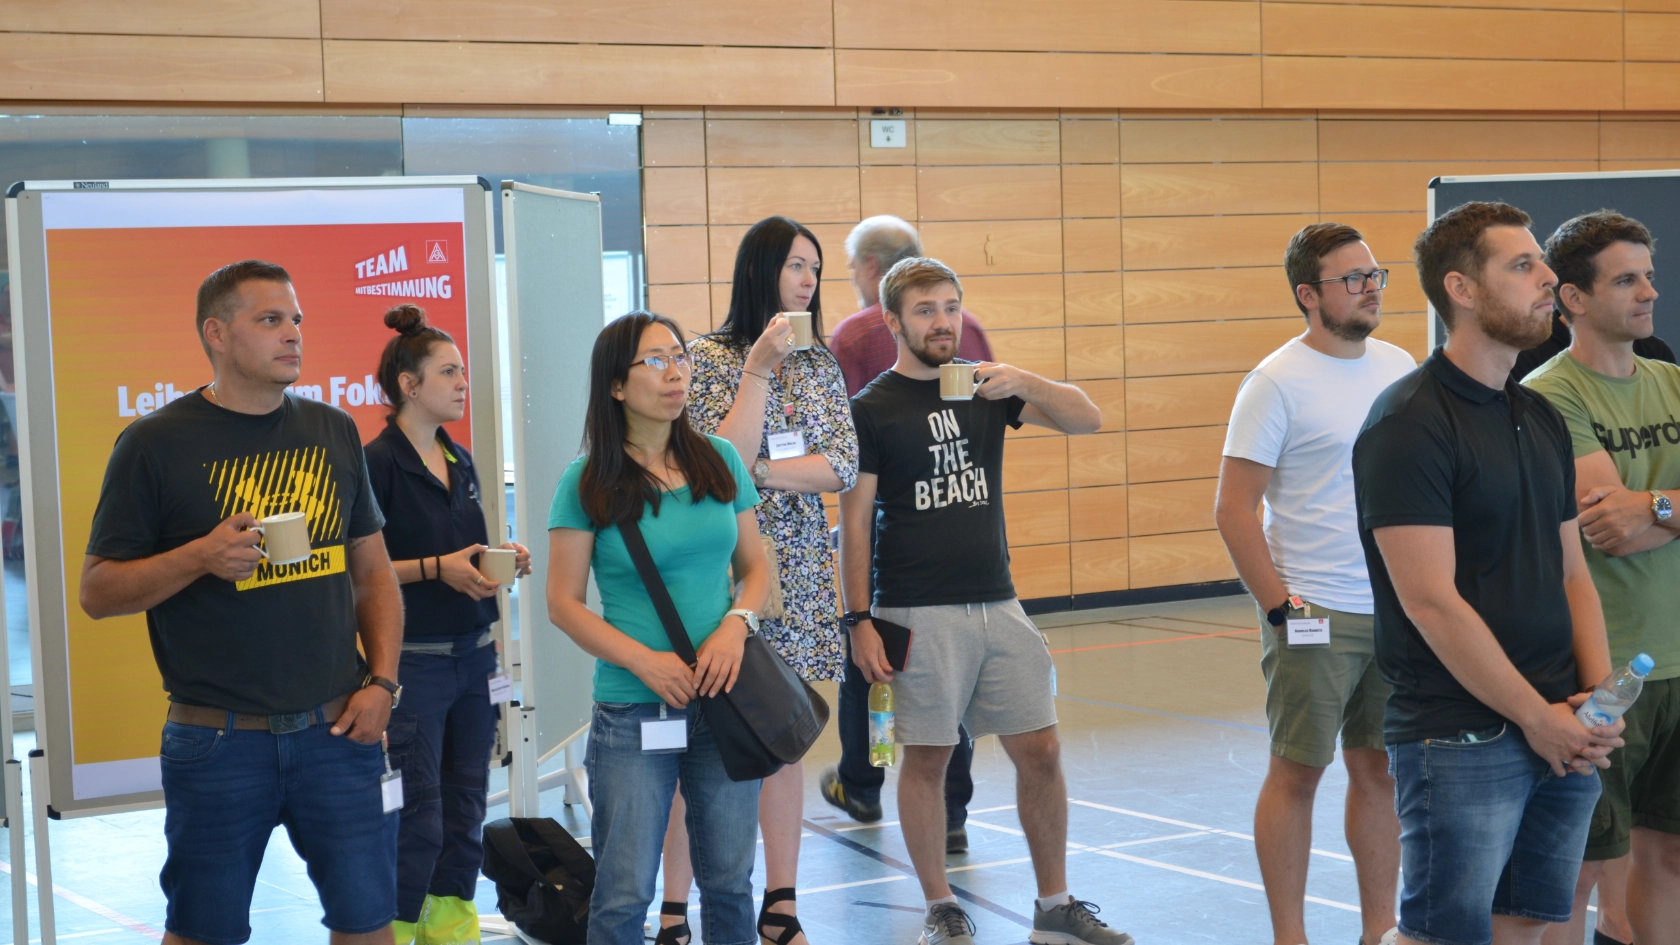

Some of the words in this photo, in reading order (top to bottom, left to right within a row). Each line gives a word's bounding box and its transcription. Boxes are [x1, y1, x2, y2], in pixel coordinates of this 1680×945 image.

[881, 125, 895, 134] WC
[82, 181, 107, 189] Neuland
[355, 245, 408, 279] TEAM
[355, 275, 452, 299] MITBESTIMMUNG
[329, 374, 391, 407] Fok
[927, 408, 961, 443] ON
[1593, 414, 1680, 459] Superd
[928, 438, 973, 476] THE
[914, 467, 989, 511] BEACH
[257, 551, 331, 582] MUNICH
